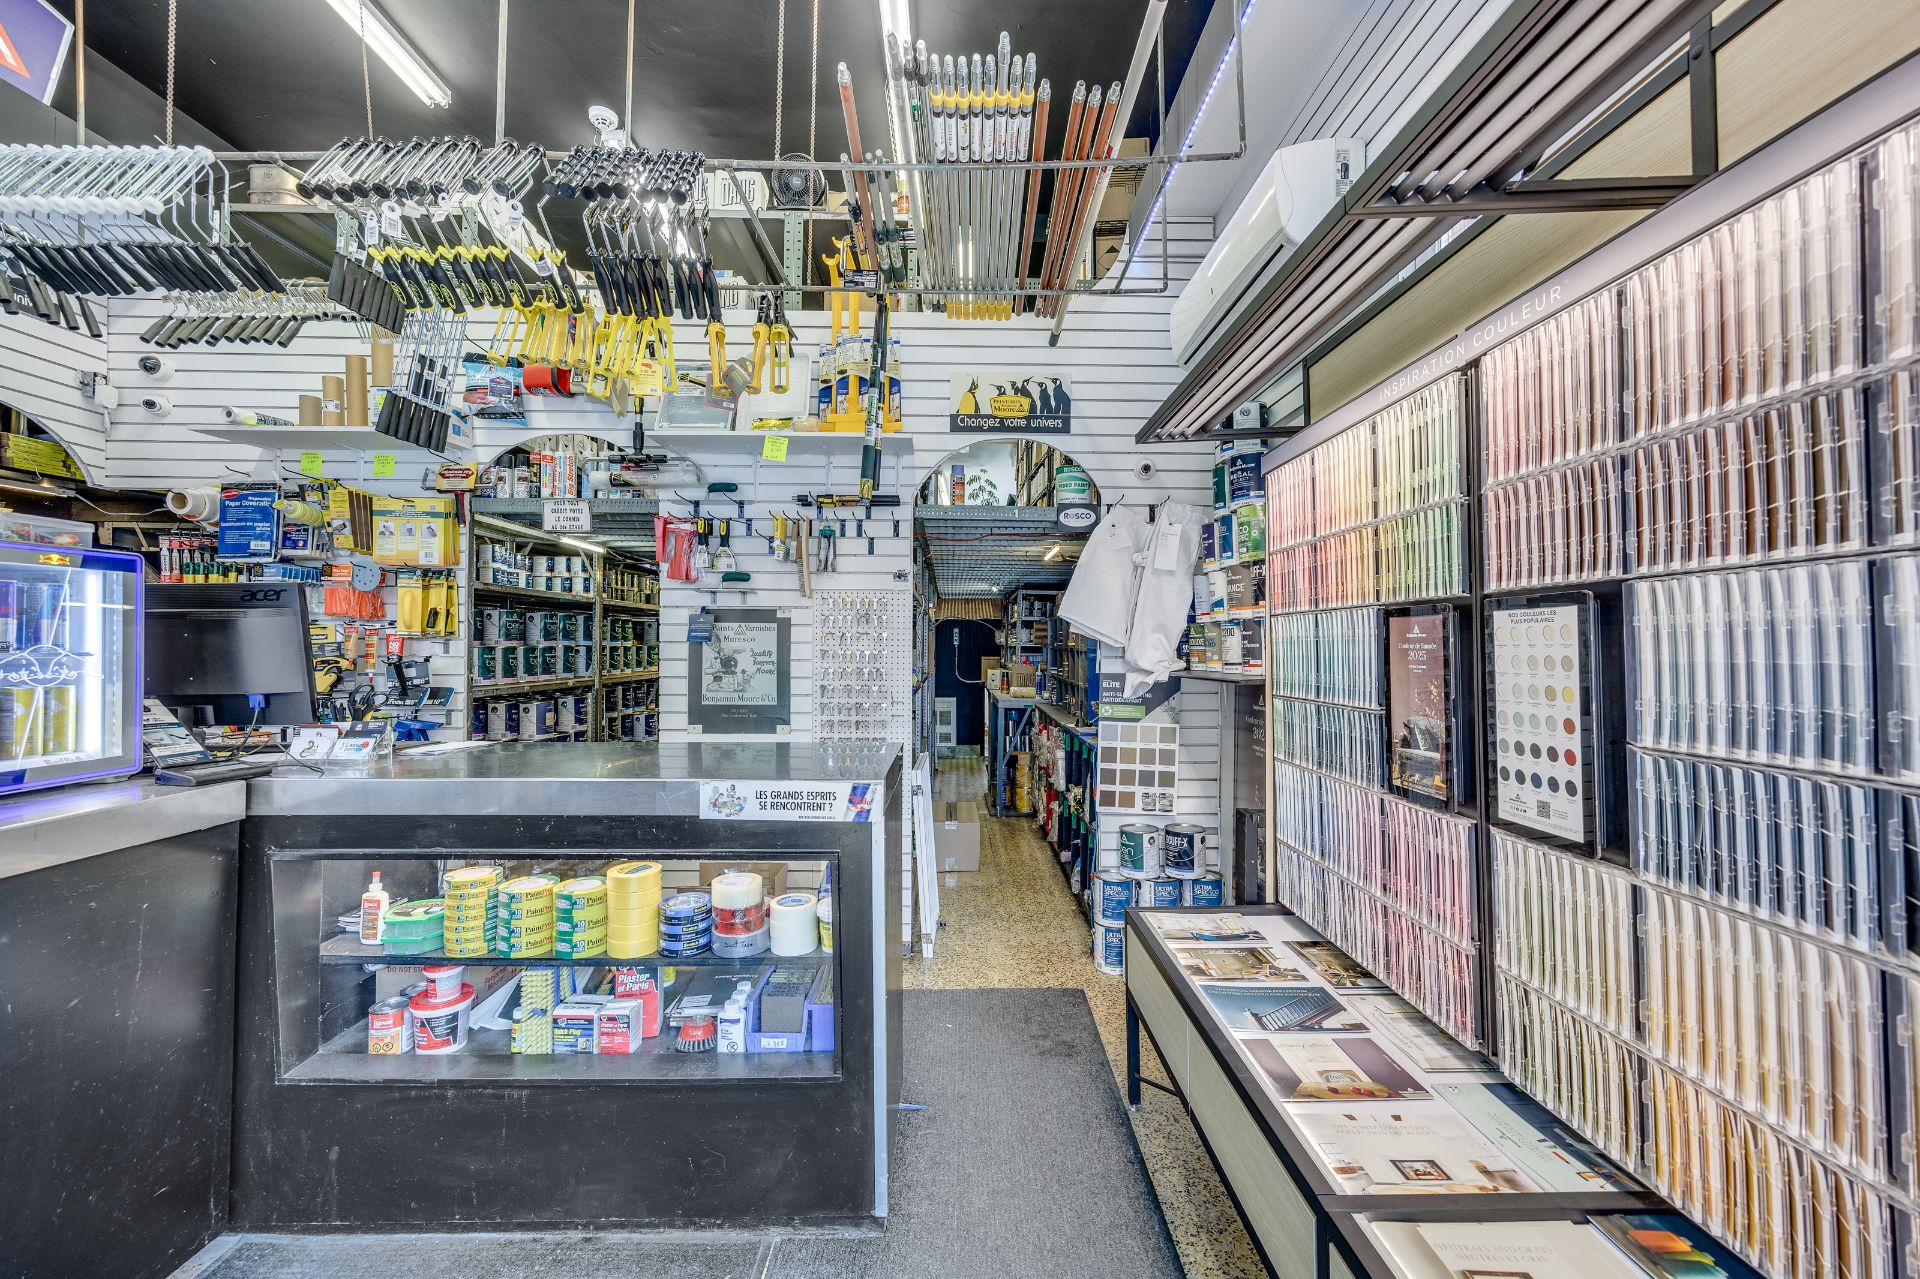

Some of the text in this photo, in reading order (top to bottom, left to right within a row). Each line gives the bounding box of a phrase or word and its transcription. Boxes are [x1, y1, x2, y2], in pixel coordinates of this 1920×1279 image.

[1379, 285, 1562, 401] INSPIRATION COULEUR
[957, 415, 1063, 429] Changez votre univers
[1063, 512, 1092, 520] ROSCO
[240, 588, 288, 602] acer
[744, 624, 776, 632] Varnishes
[723, 635, 756, 643] Muresco
[750, 648, 774, 659] Quality
[1407, 650, 1427, 661] 2025
[702, 694, 736, 704] Benjamin
[737, 694, 761, 702] Moore
[755, 790, 837, 801] LES GRANDS ESPRITS
[758, 801, 768, 810] SE
[770, 801, 826, 812] RENCONTRENT
[1166, 834, 1188, 848] SCUFF-X
[525, 887, 552, 899] PaintPro
[526, 904, 552, 915] PaintPro
[525, 921, 552, 934] PaintPro
[525, 936, 552, 948] PaintPro
[723, 939, 753, 949] Duct Tape
[618, 973, 650, 984] Plaster
[617, 981, 649, 992] of Paris
